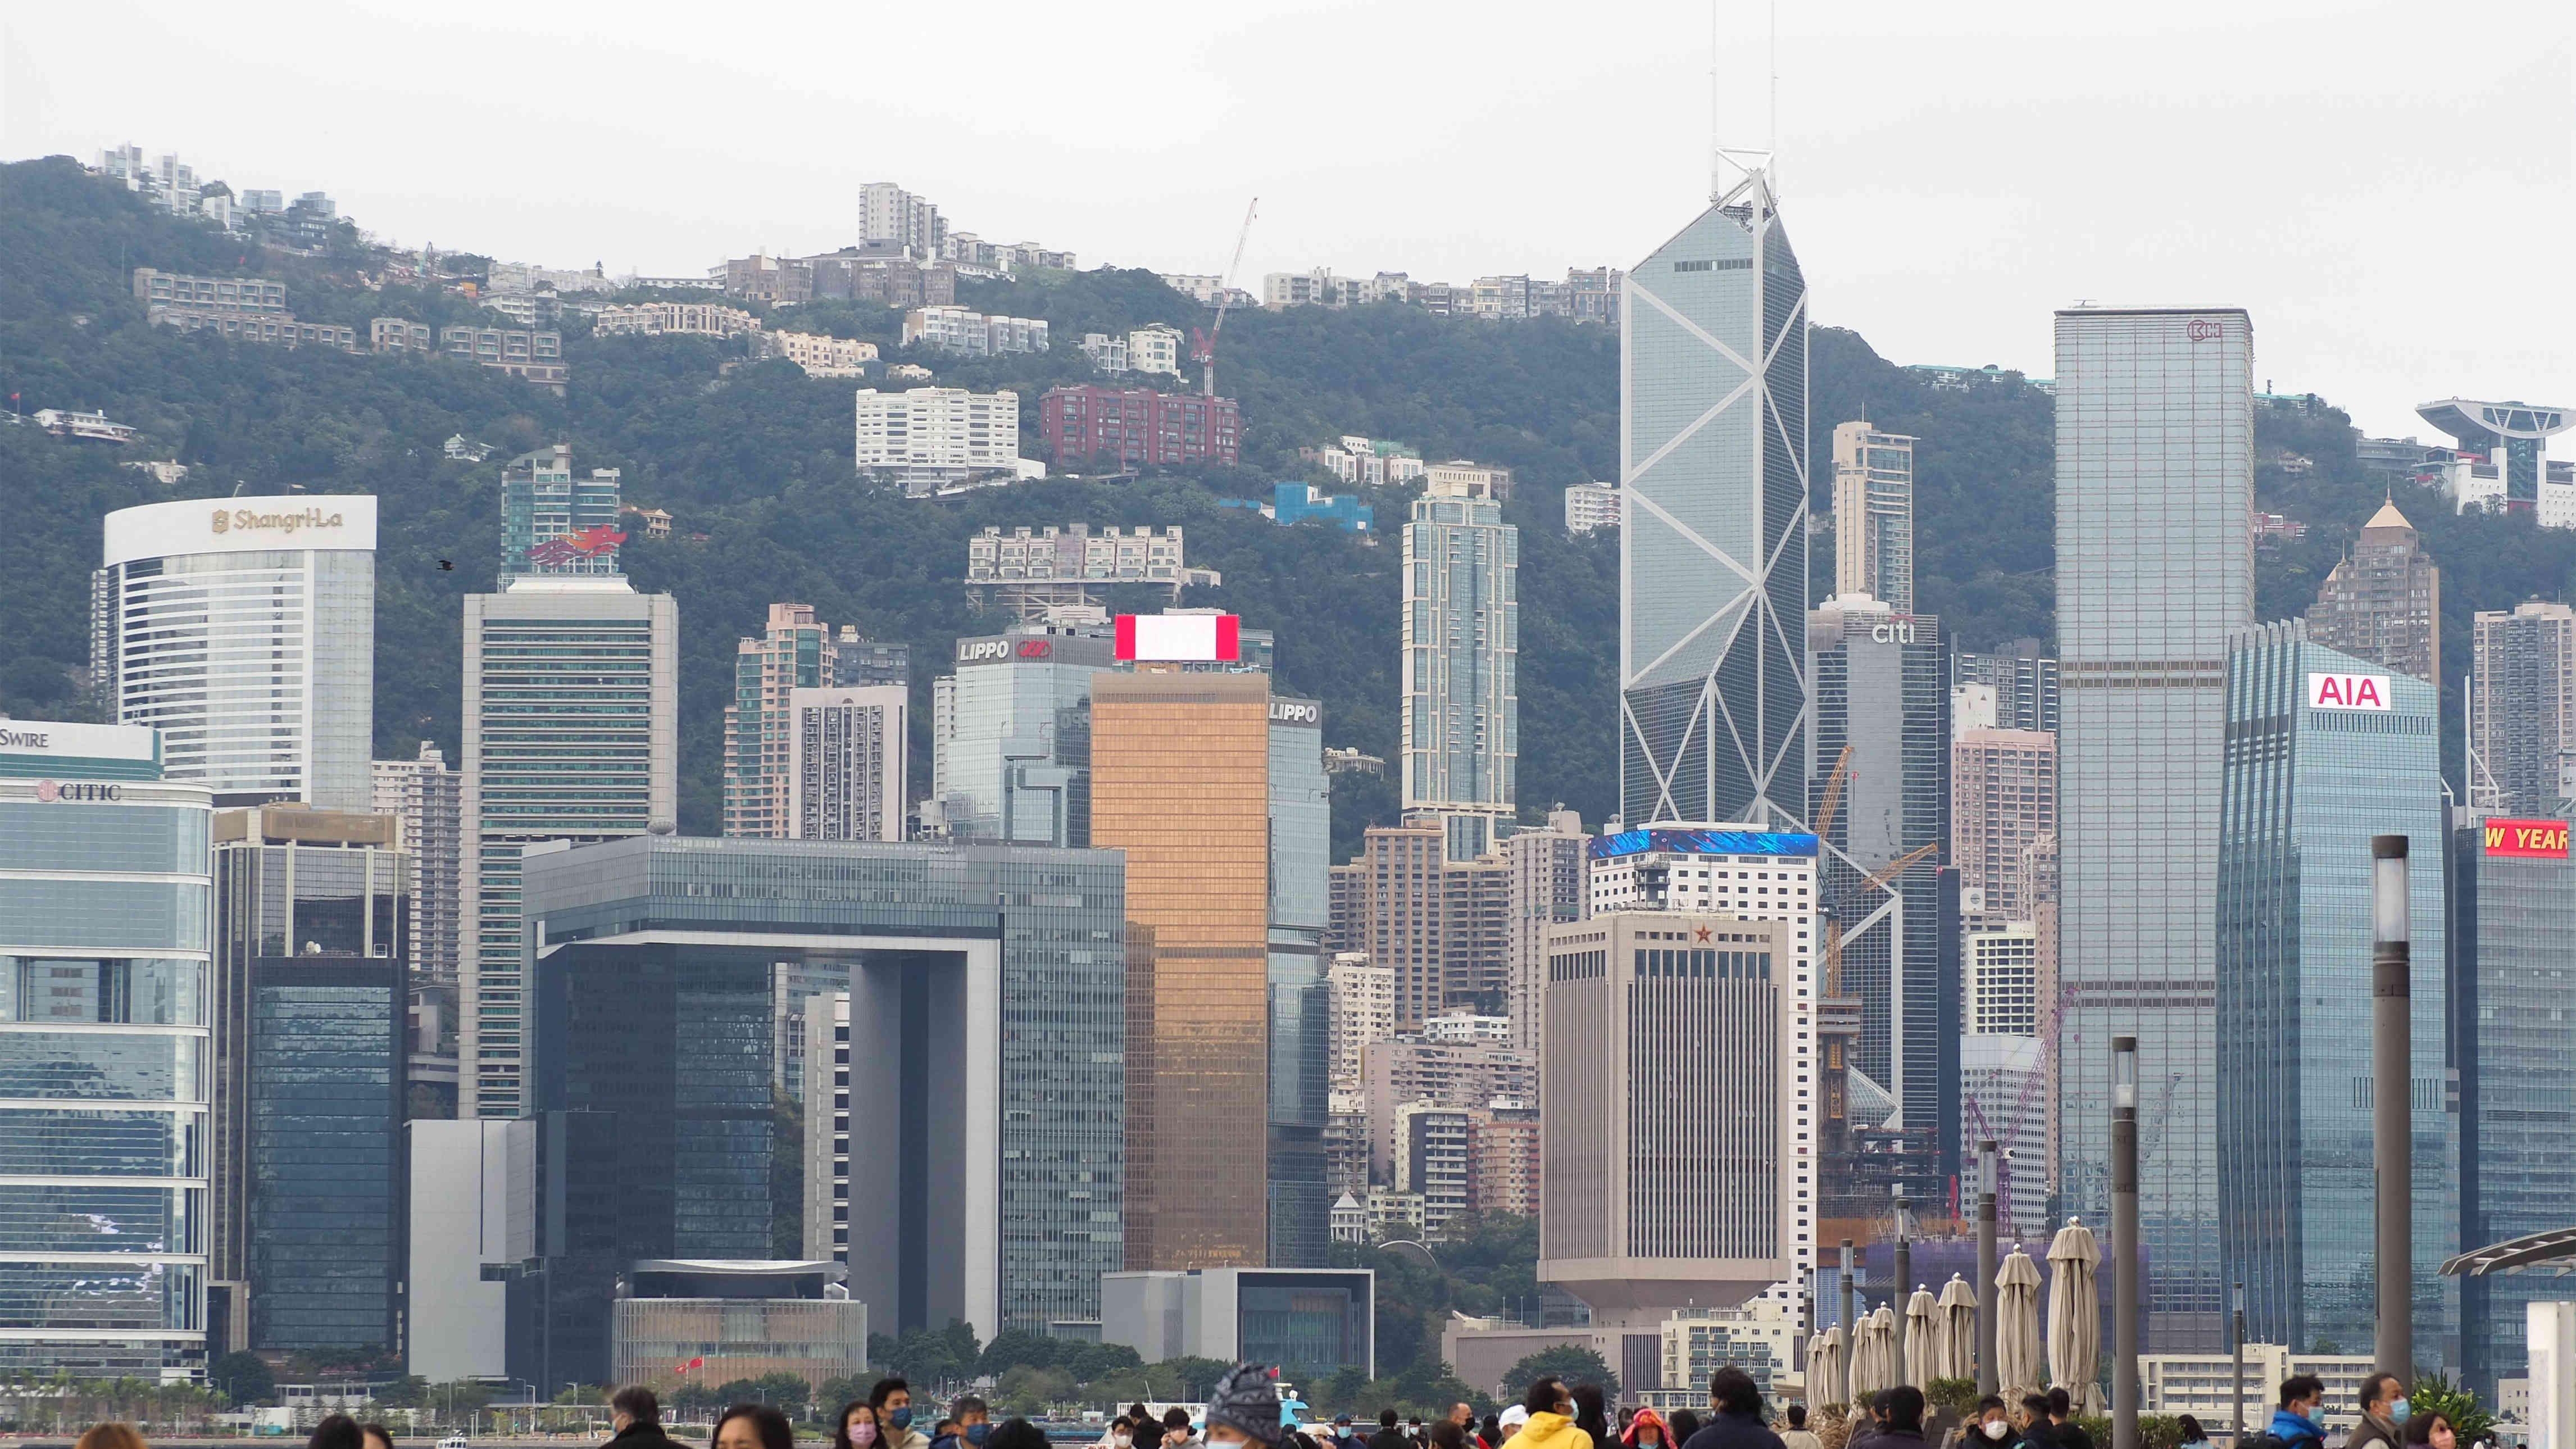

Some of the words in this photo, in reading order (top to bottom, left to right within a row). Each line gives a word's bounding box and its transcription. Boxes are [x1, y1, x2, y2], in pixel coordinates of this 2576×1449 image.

[234, 507, 343, 534] Shangri-La
[1872, 620, 1915, 643] citi
[960, 641, 1008, 661] LIPPO
[2318, 677, 2380, 706] AIA
[1269, 703, 1317, 723] LIPPO
[61, 783, 121, 801] CITIC
[2486, 828, 2506, 847] W
[2515, 828, 2568, 850] YEAR
